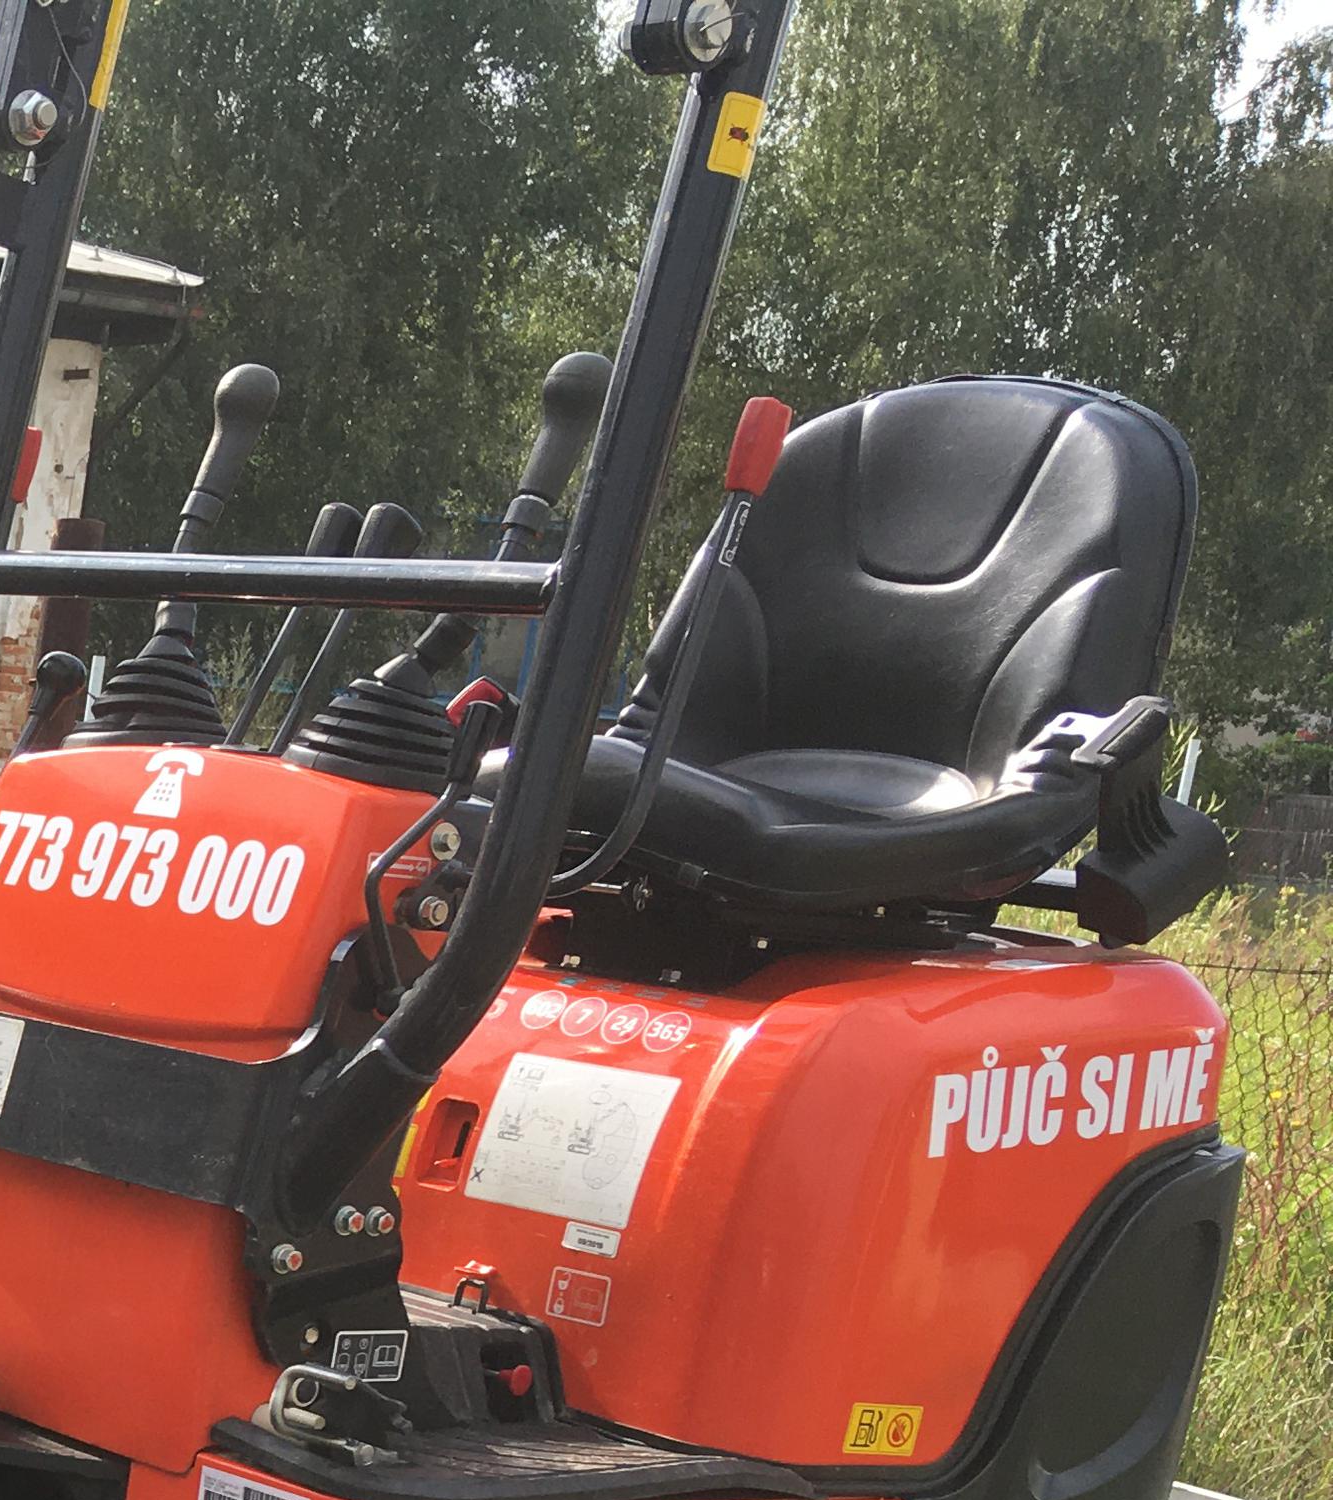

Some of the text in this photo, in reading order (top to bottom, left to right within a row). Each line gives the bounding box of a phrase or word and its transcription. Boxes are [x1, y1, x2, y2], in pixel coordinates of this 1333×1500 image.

[71, 821, 179, 908] 973
[177, 834, 306, 926] 000
[576, 1008, 593, 1025] 7
[610, 1015, 638, 1037] 24
[646, 1021, 688, 1042] 365
[927, 1027, 1215, 1158] PŮJČ SI MĚ
